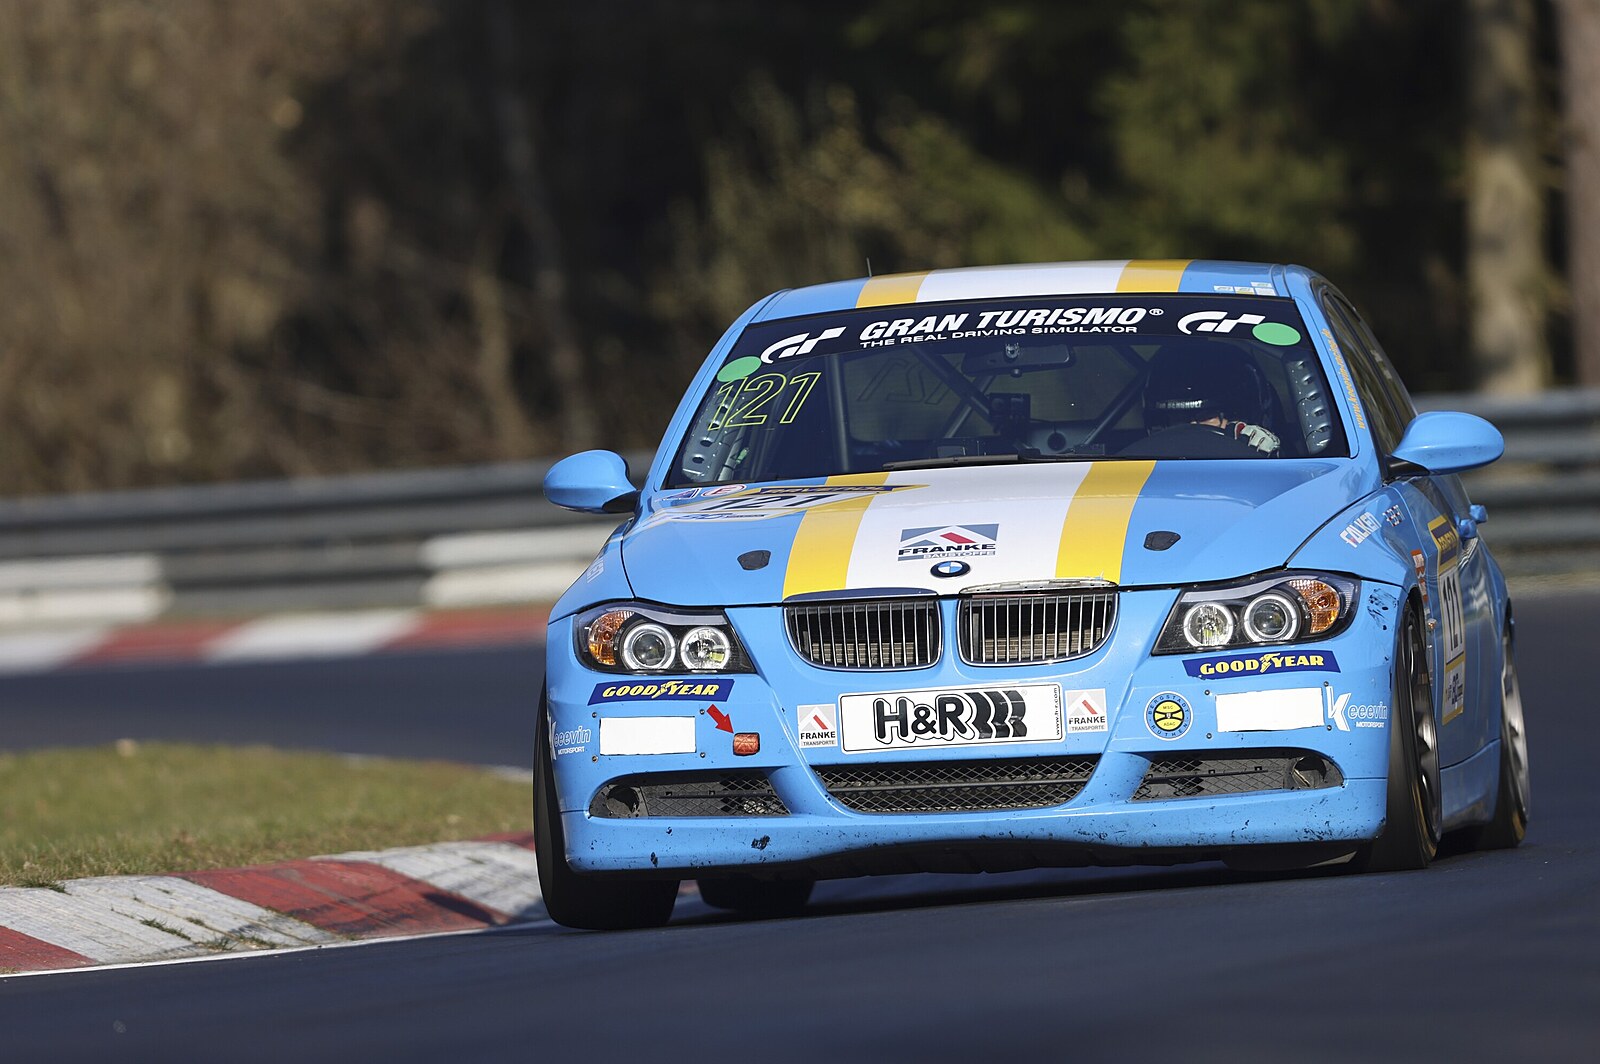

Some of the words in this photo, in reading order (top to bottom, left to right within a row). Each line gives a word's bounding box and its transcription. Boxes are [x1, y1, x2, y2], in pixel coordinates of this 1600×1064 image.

[859, 313, 969, 341] GRAN
[860, 338, 895, 349] THE
[900, 333, 947, 344] REAL
[952, 327, 1026, 339] DRIVING
[1031, 326, 1137, 334] SIMULATOR
[708, 371, 822, 432] 121
[700, 493, 841, 511] 121
[898, 543, 996, 556] FRANKE
[873, 694, 976, 744] H&R
[1068, 715, 1106, 725] FRANKE
[800, 730, 836, 740] FRANKE
[557, 746, 585, 755] MOTORSPORT
